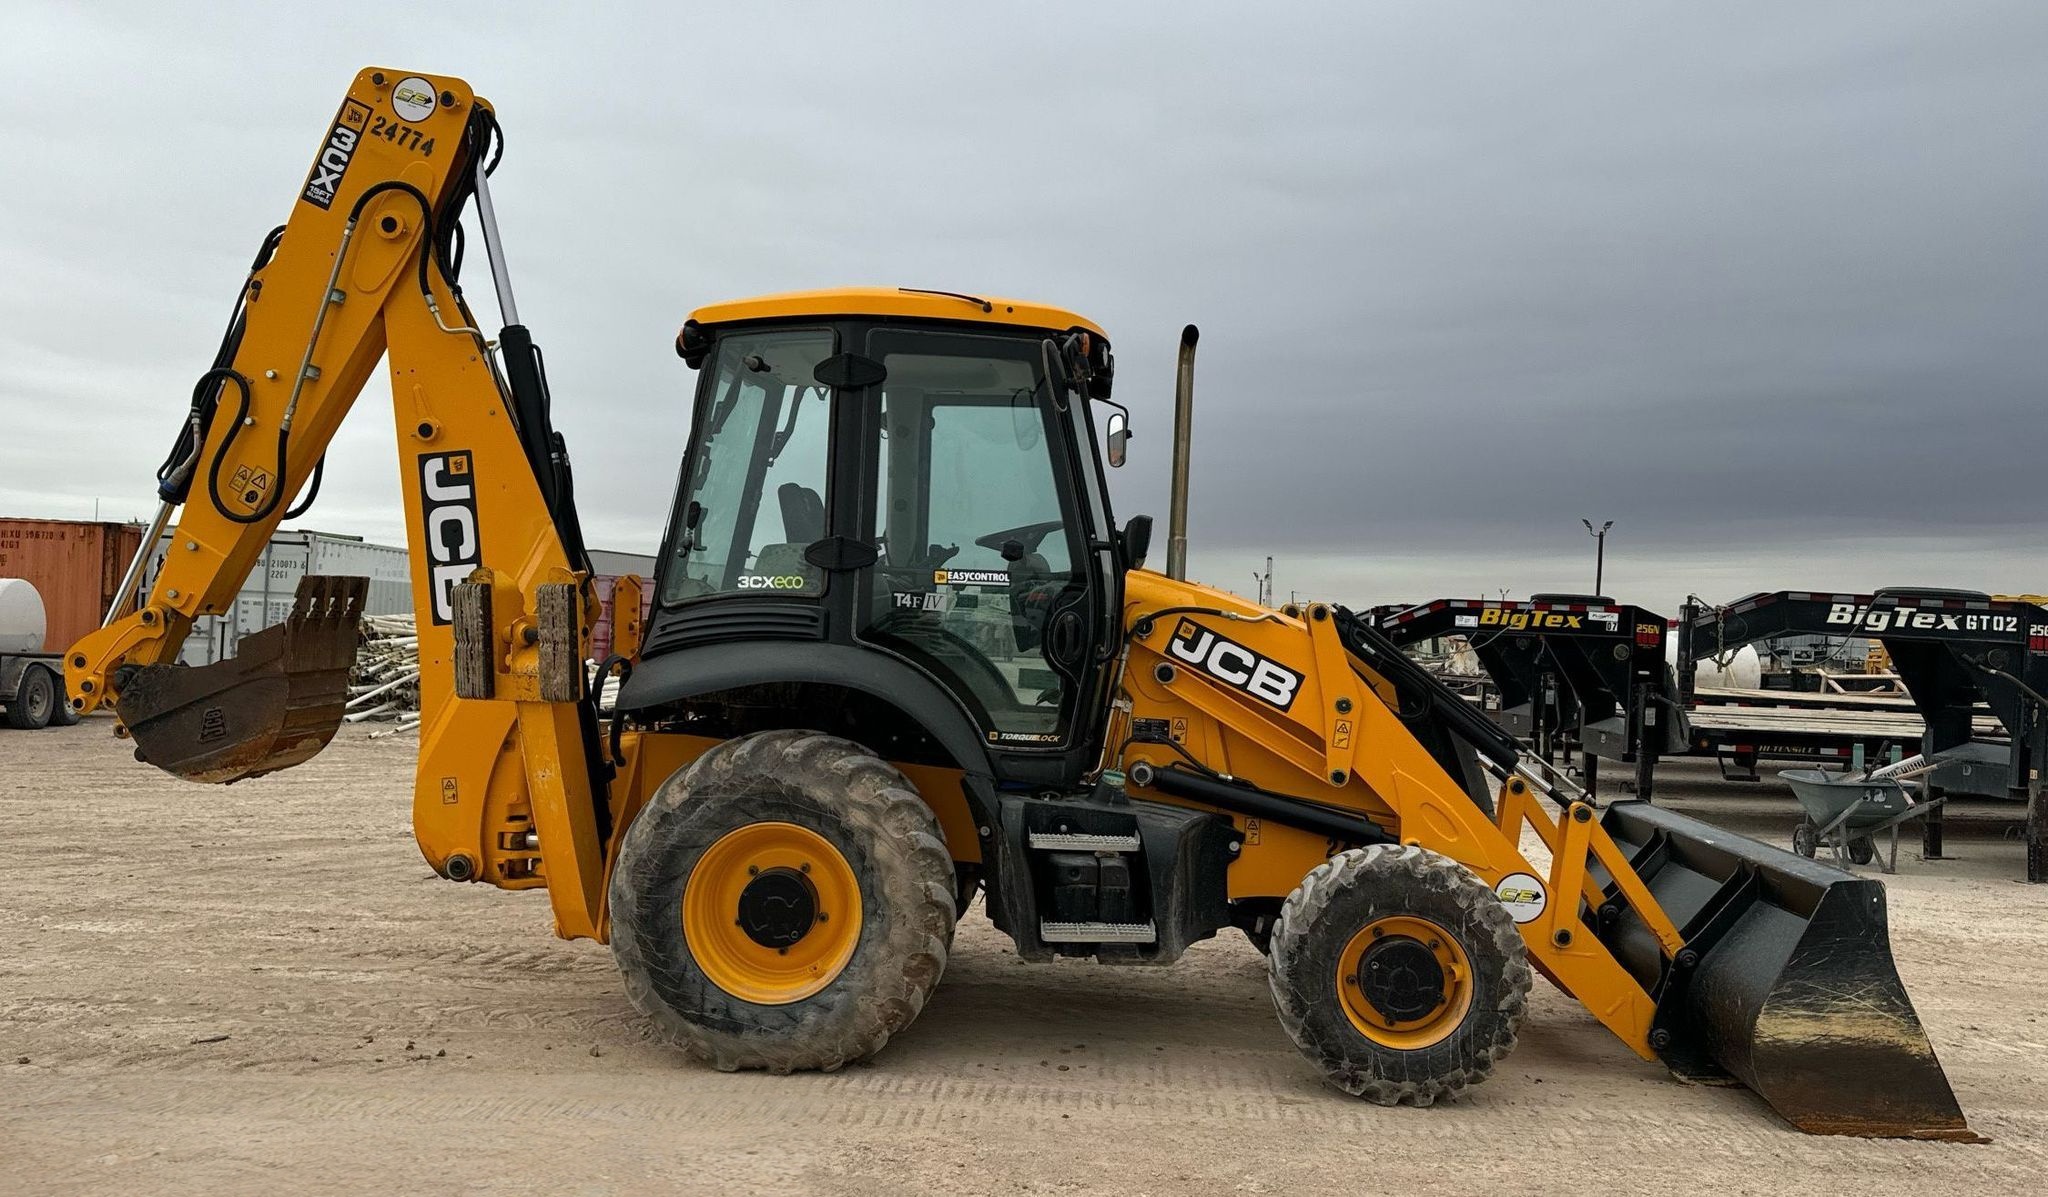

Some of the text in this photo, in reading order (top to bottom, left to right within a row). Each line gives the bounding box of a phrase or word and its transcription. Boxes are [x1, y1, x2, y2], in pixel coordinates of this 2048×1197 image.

[371, 116, 435, 157] 24774
[311, 126, 357, 193] 3CX
[306, 191, 330, 205] SUPER
[309, 185, 332, 199] 15FT
[271, 559, 297, 569] 210073
[737, 575, 804, 589] 3CXeco
[947, 571, 1010, 583] EASYCONTROL
[1606, 621, 1618, 631] 07
[1966, 614, 2018, 632] GT02
[1171, 631, 1298, 706] JCB
